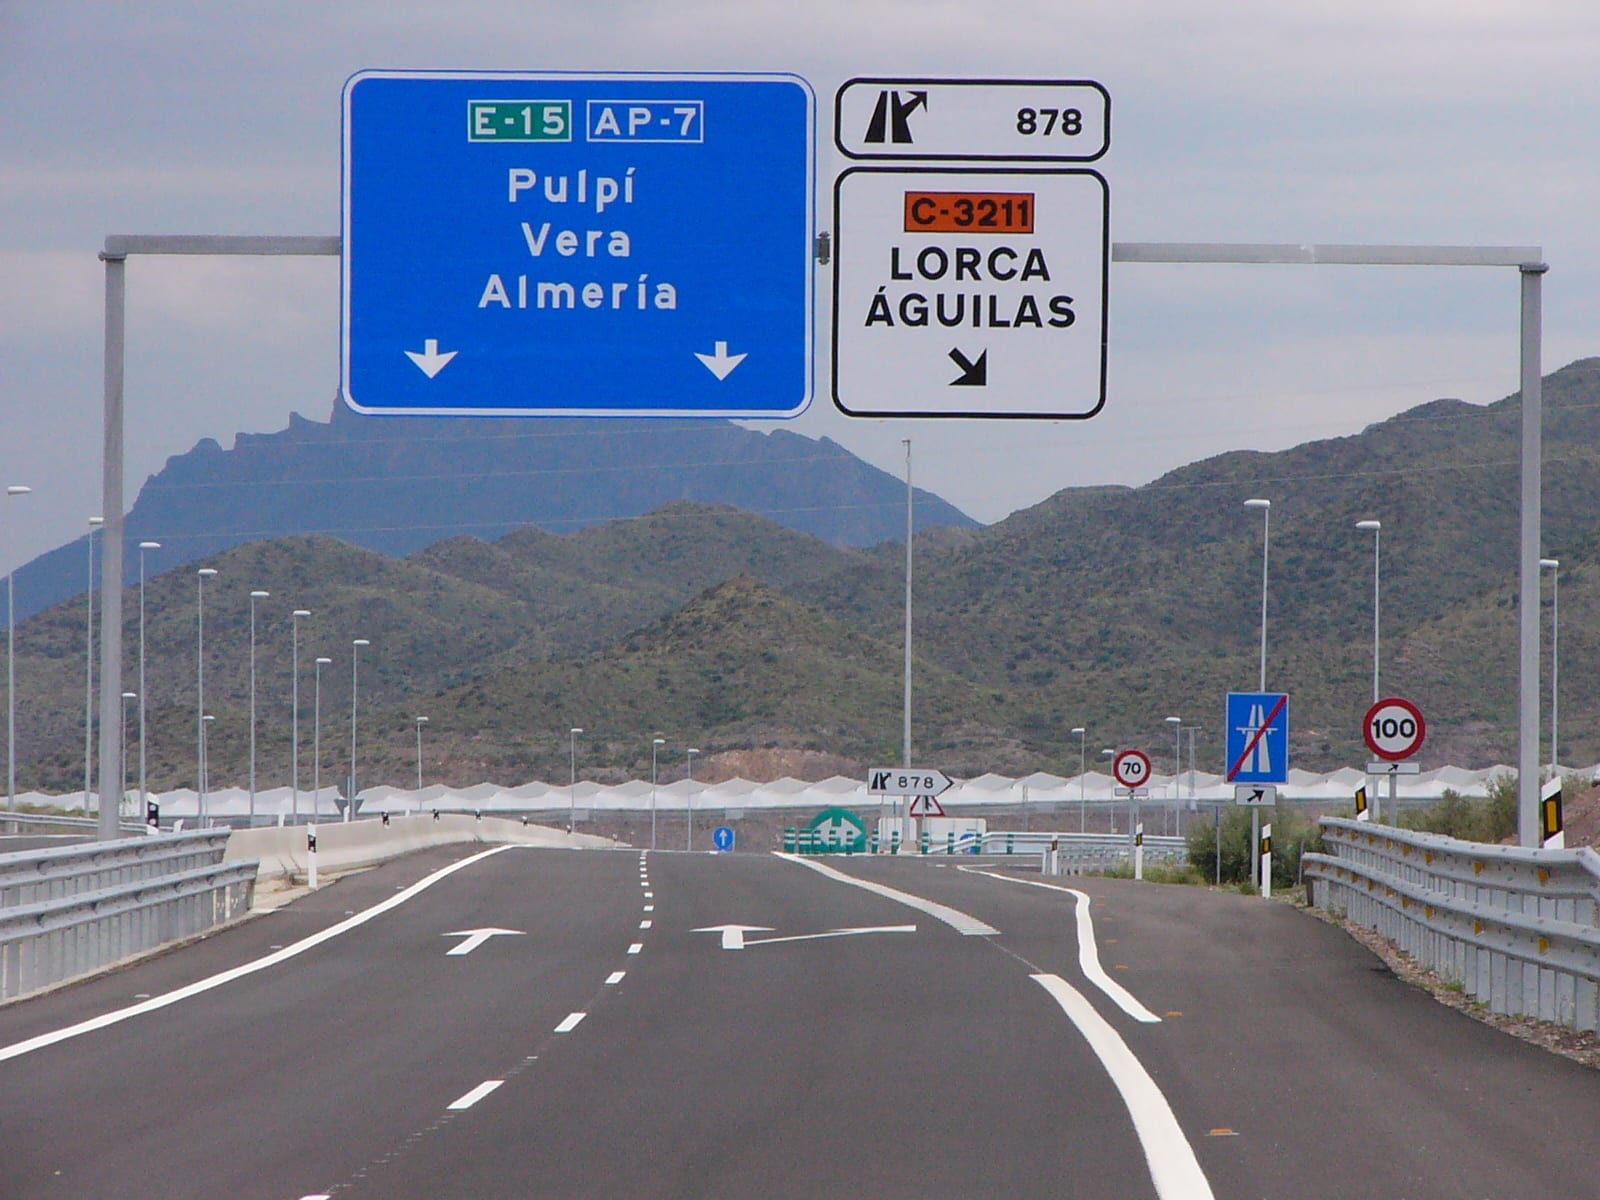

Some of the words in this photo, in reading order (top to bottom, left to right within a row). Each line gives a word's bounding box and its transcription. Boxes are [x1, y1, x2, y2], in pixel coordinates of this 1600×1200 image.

[474, 106, 566, 136] E-15
[594, 106, 697, 136] AP-7
[1016, 108, 1083, 137] 878
[508, 167, 636, 213] Pulpí
[911, 197, 1029, 227] C-3211
[521, 222, 631, 257] Vera
[891, 246, 1051, 282] LORCA
[478, 273, 678, 310] Almería
[865, 285, 1076, 328] ÁGUILAS
[1372, 718, 1416, 739] 100
[898, 776, 934, 789] 878
[1123, 762, 1141, 776] 70
